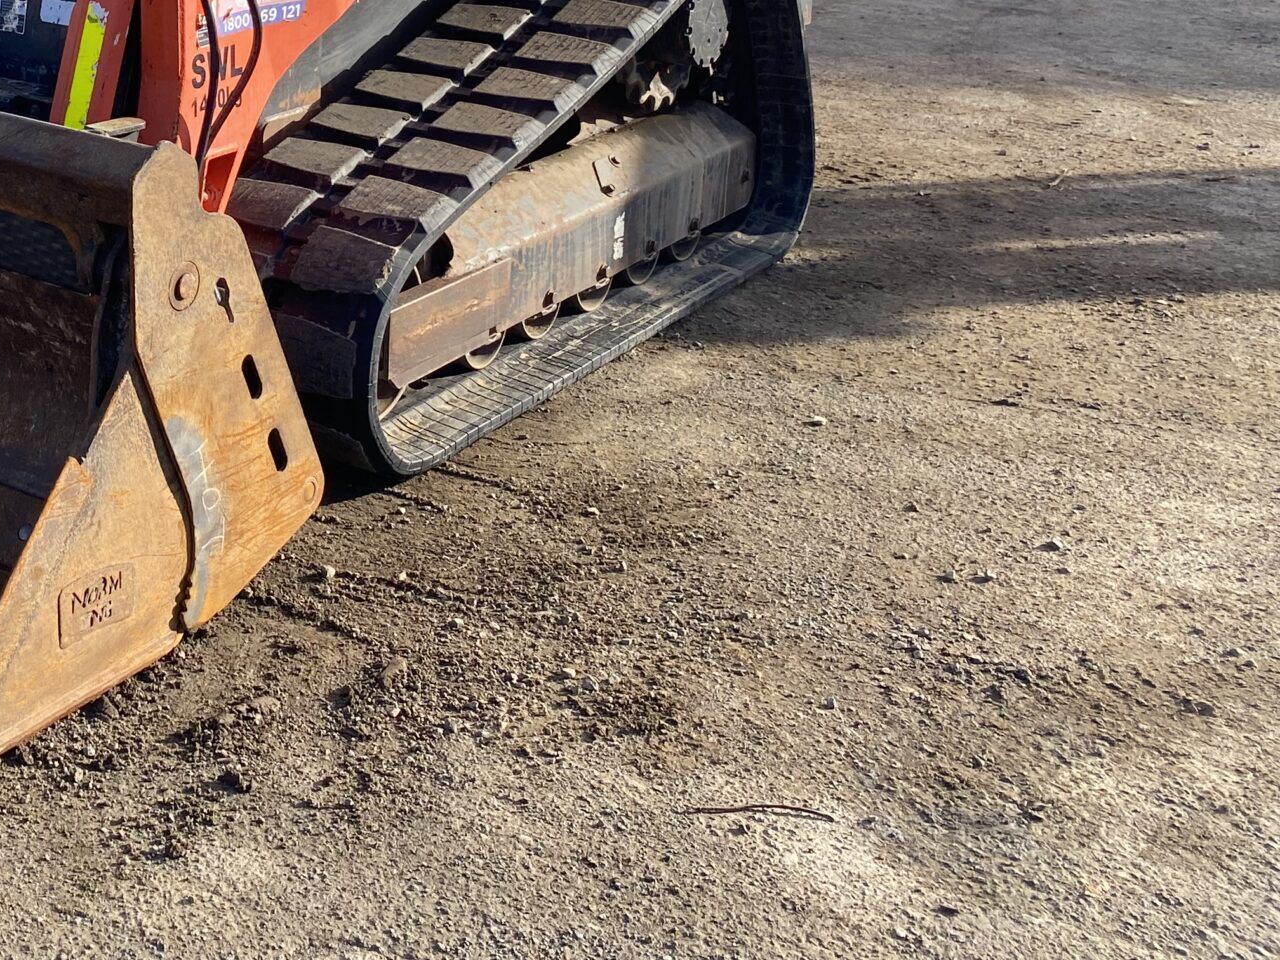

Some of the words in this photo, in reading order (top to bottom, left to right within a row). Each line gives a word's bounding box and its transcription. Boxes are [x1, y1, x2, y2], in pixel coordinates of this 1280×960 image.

[223, 12, 251, 33] 1800
[252, 7, 278, 23] 69
[281, 3, 302, 19] 121
